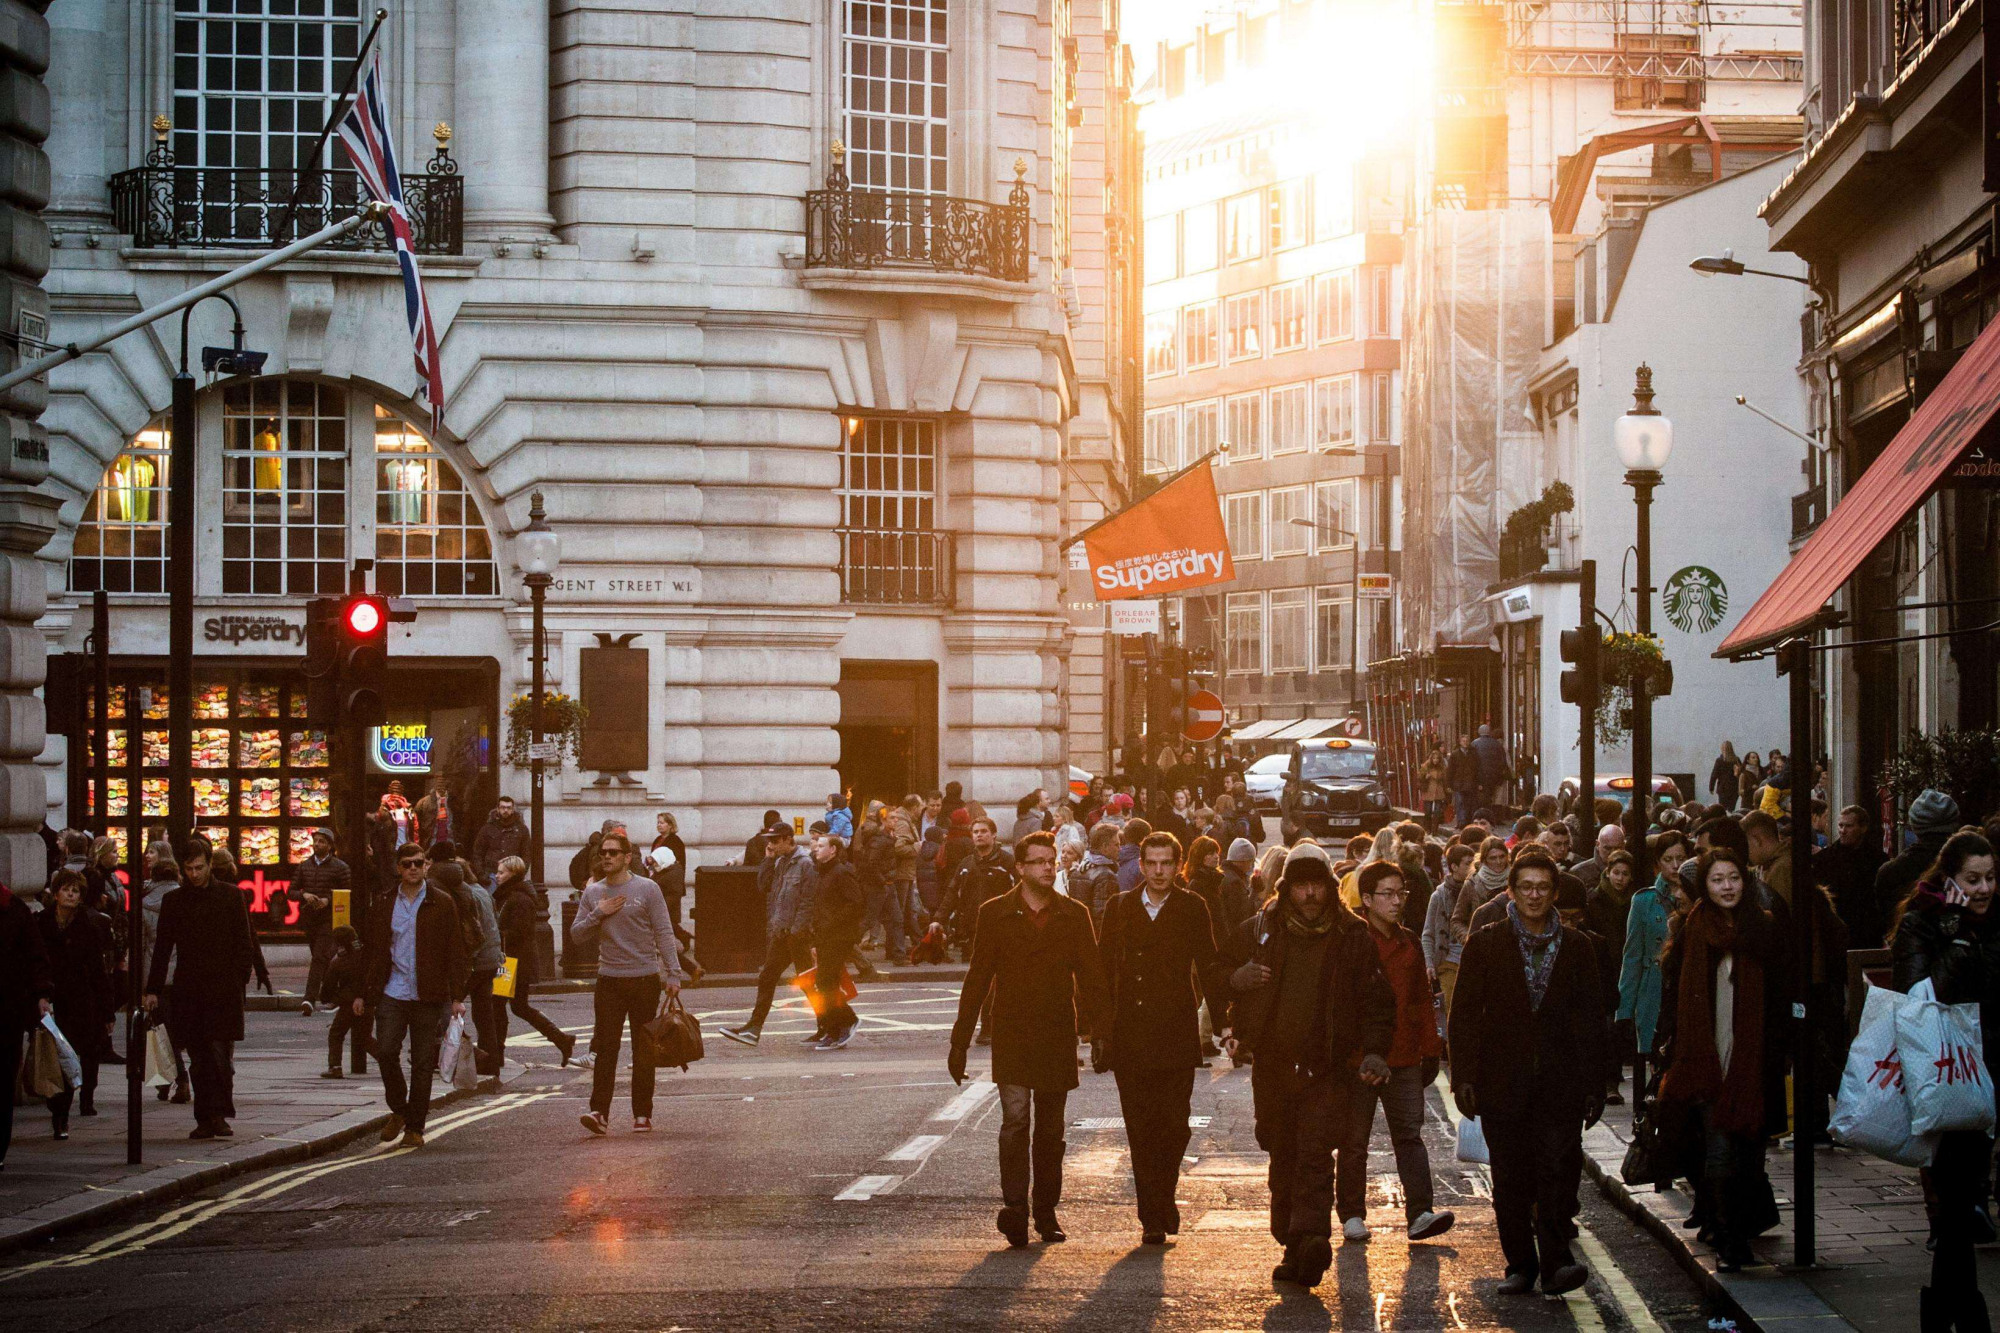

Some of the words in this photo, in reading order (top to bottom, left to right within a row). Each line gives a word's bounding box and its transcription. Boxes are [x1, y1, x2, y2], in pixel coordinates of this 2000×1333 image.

[1069, 560, 1080, 568] ET
[1096, 548, 1225, 591] Superdry
[547, 579, 595, 591] GENT
[608, 580, 662, 592] STREET
[204, 618, 307, 646] Superdry
[382, 724, 427, 739] T-SHIRT
[1933, 1041, 1982, 1087] H&M
